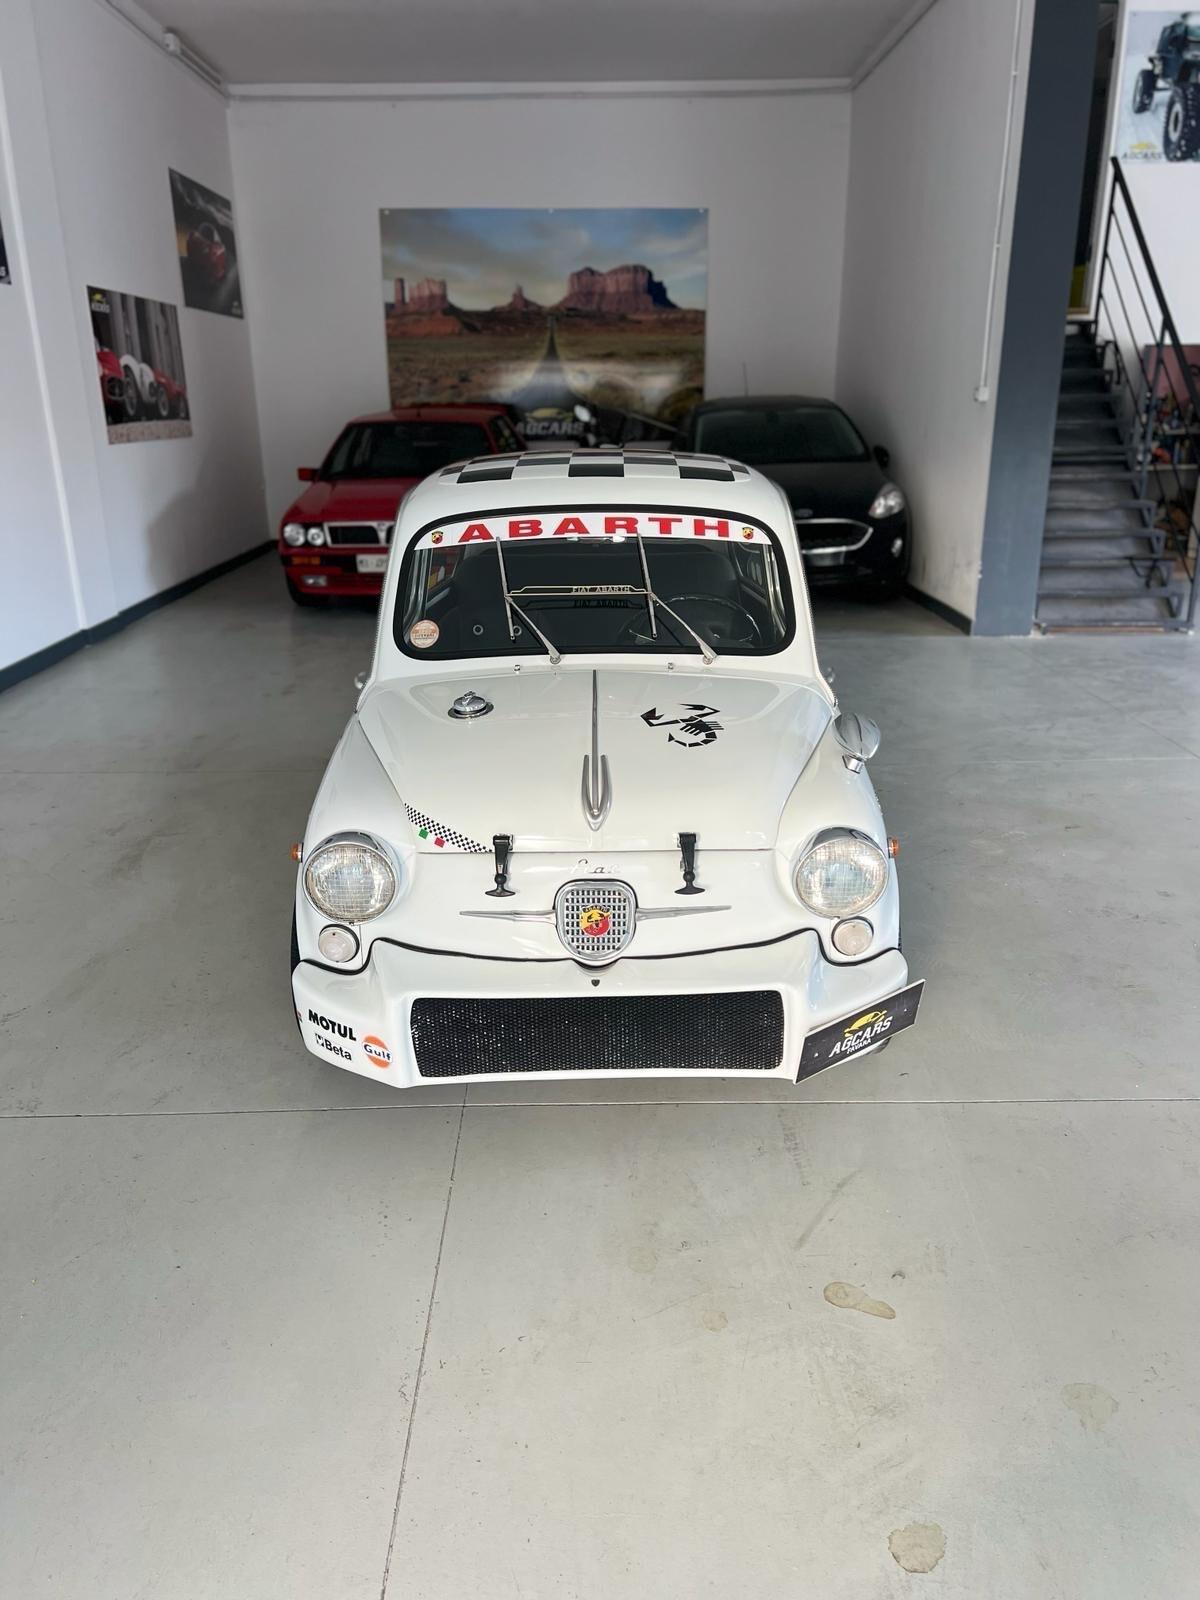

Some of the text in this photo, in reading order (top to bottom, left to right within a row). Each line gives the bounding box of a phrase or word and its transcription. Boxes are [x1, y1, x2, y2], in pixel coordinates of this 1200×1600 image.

[458, 516, 730, 543] ABARTH
[596, 585, 631, 593] ABARTH
[308, 1008, 357, 1041] MOTUL
[828, 1015, 894, 1058] AGCARS
[324, 1038, 353, 1061] Beta
[363, 1043, 391, 1061] Gulf
